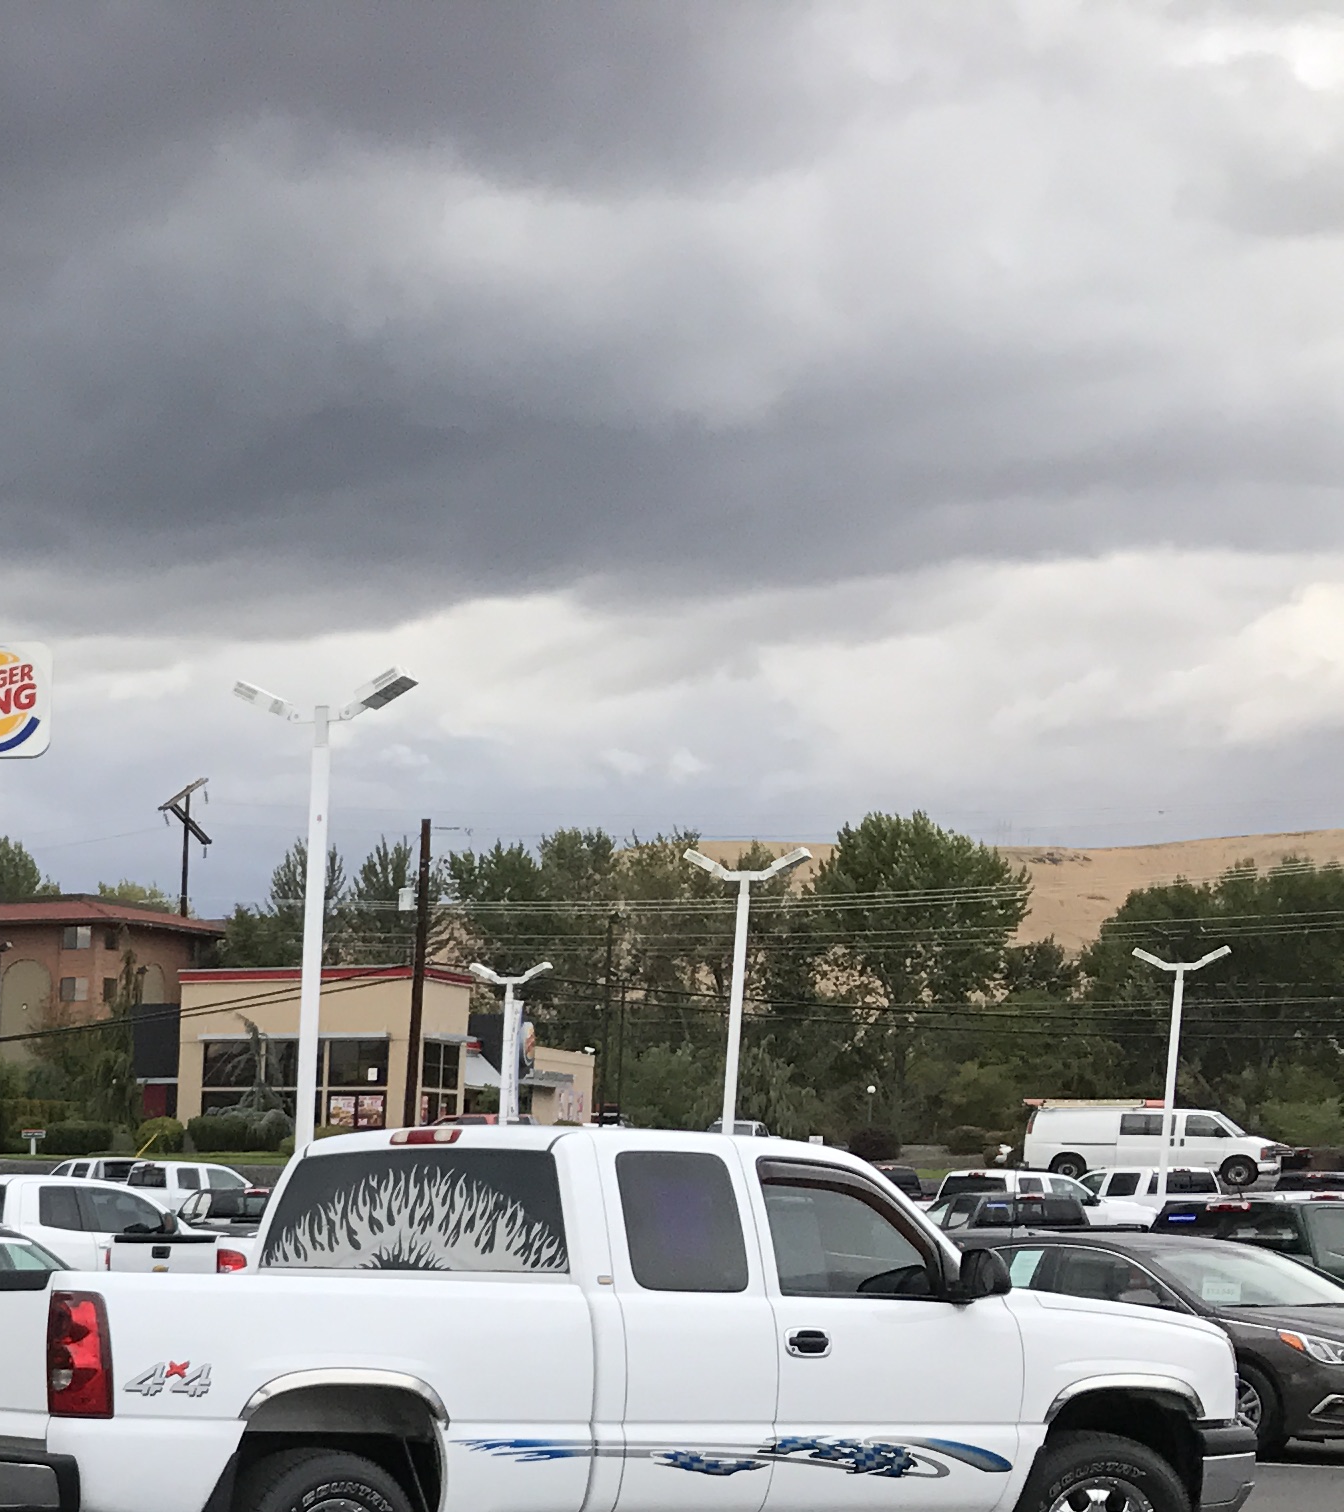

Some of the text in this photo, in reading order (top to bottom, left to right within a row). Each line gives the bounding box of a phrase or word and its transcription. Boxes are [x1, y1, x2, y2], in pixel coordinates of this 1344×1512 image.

[122, 1360, 212, 1398] 4x4
[302, 1481, 394, 1512] COUNTRY
[1049, 1462, 1147, 1498] COUNTRY
